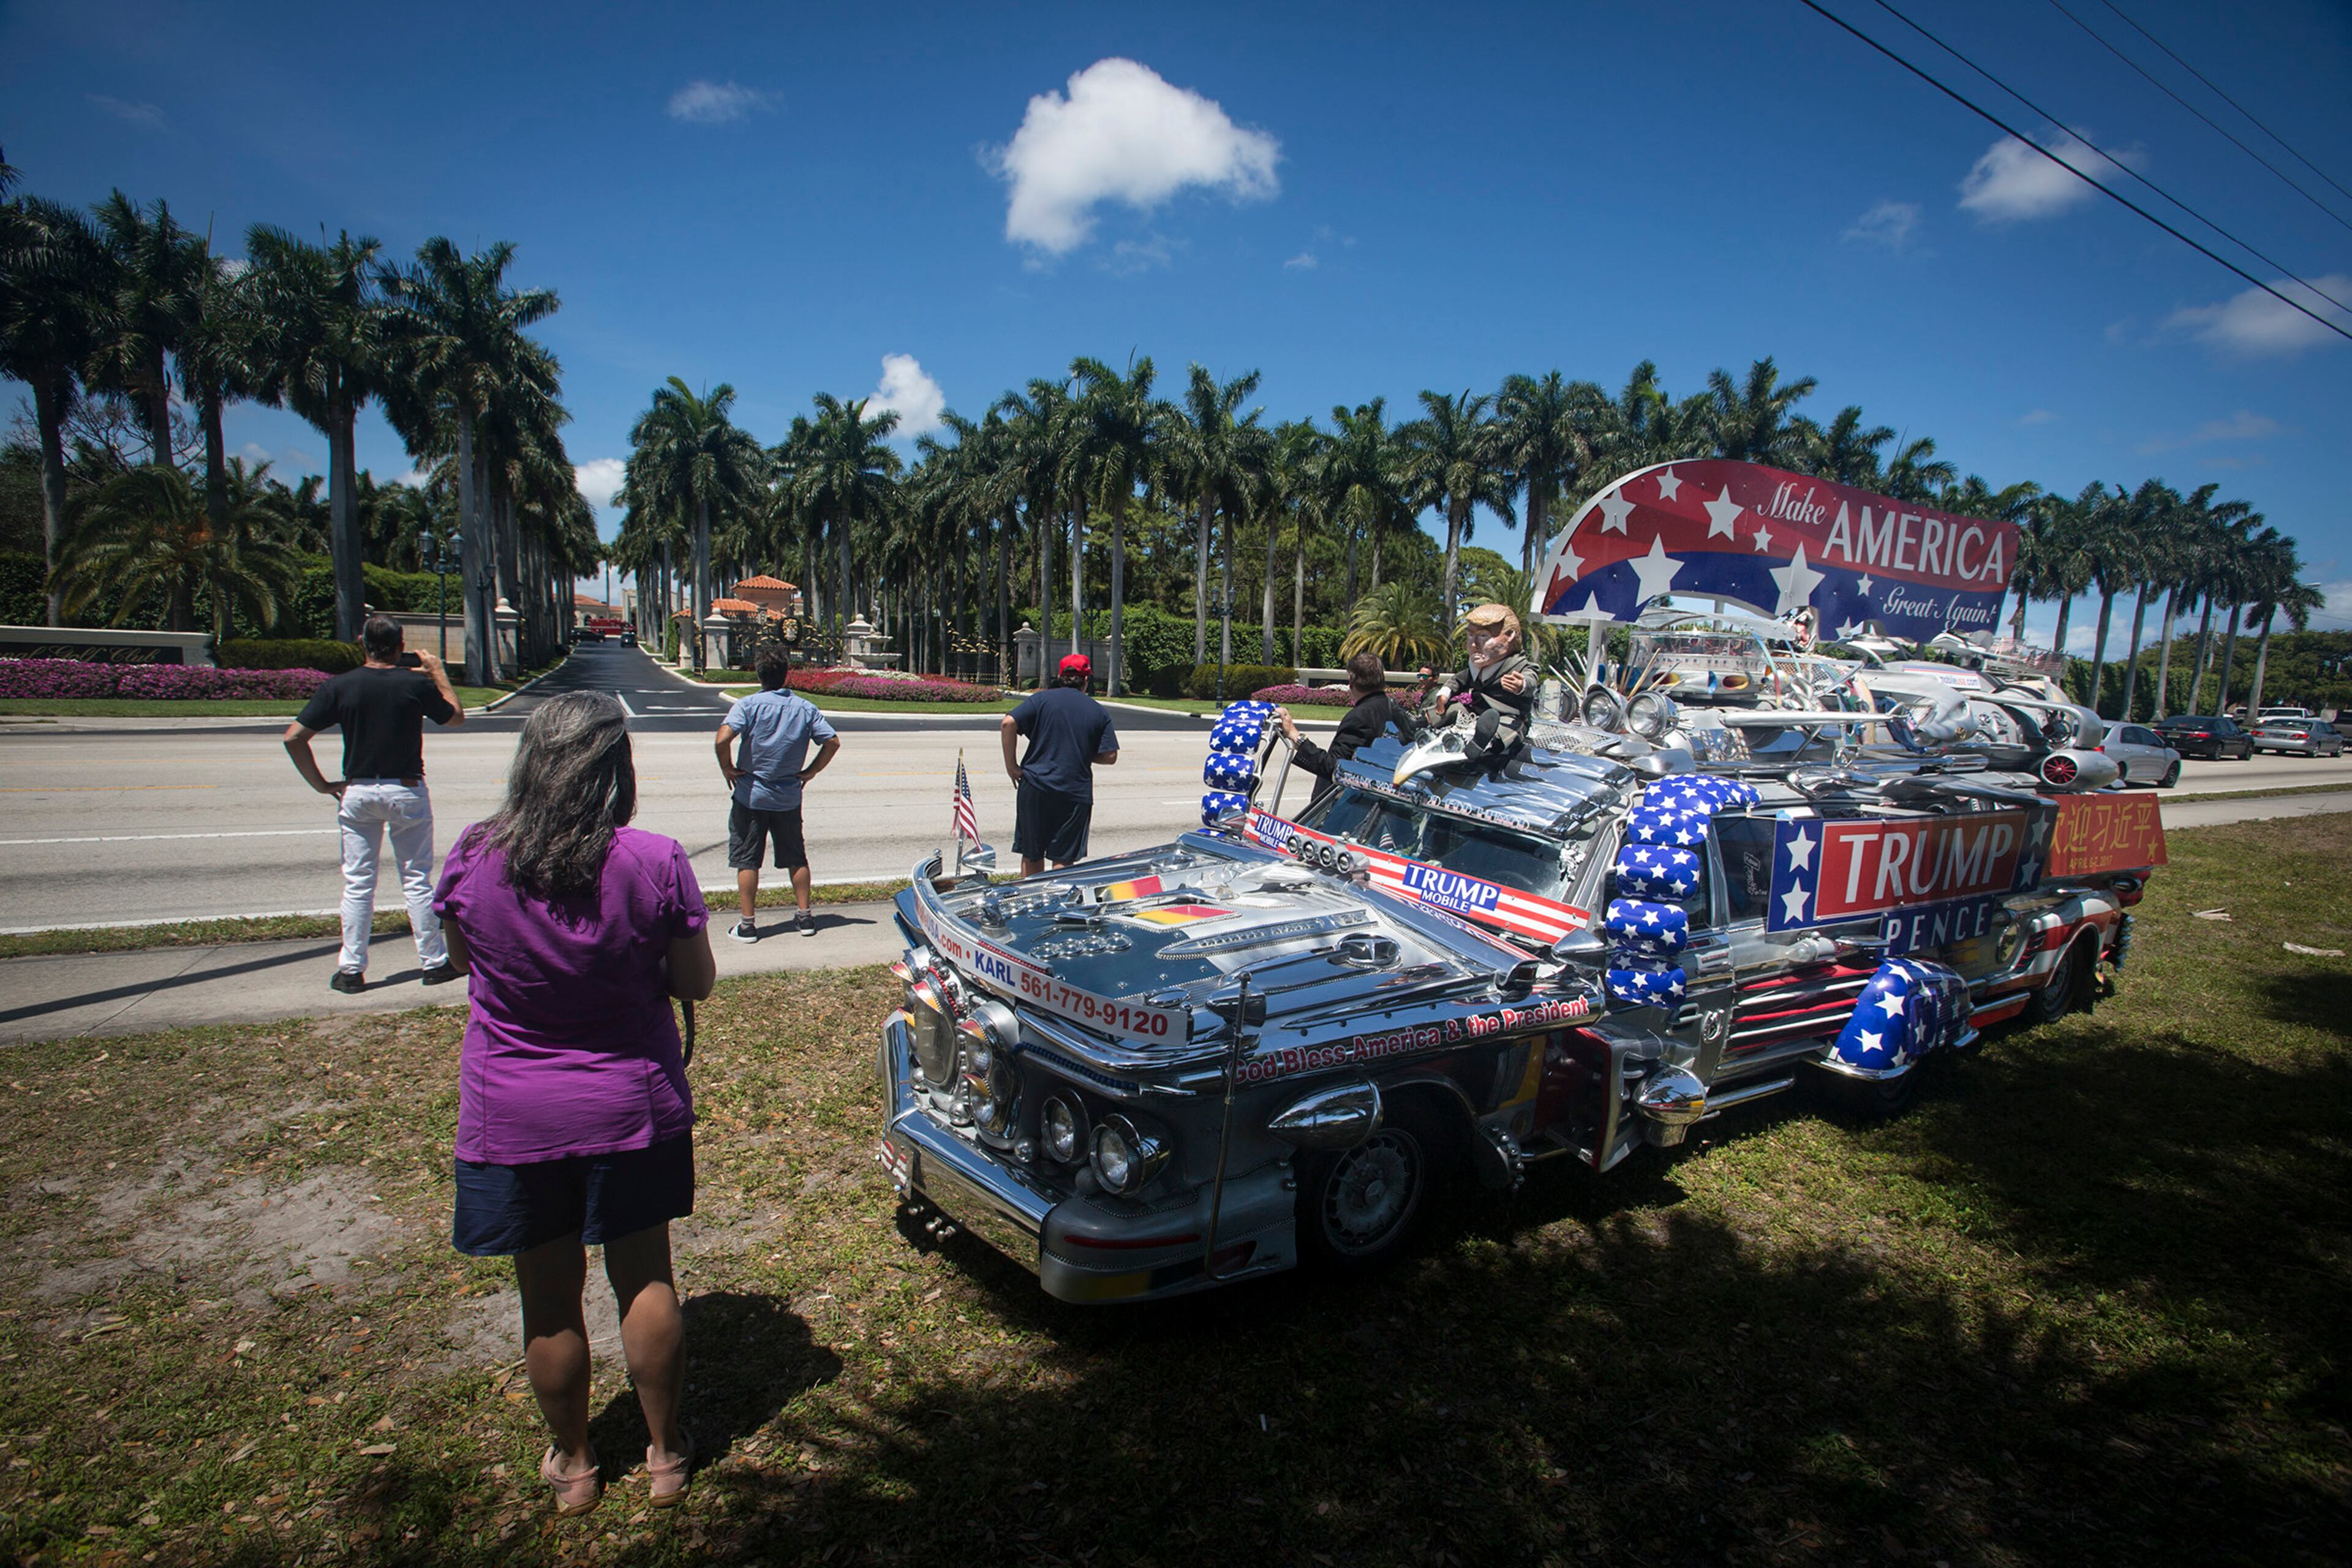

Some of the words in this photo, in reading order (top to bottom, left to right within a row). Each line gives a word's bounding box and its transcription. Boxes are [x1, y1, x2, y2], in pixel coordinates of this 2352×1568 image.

[1757, 481, 1827, 525] Make
[1821, 500, 2003, 584] AMERICA
[1883, 584, 1936, 619] Great
[1935, 594, 1997, 629] Again!
[49, 645, 107, 662] Golf
[110, 647, 161, 663] Club
[1257, 813, 1294, 842] TRUMP
[1259, 833, 1279, 848] MOBILE
[1839, 824, 2013, 903] TRUMP
[2068, 858, 2087, 869] APRIL
[2100, 855, 2113, 867] 2017
[1409, 864, 1498, 906] TRUMP
[1422, 889, 1470, 912] MOBILE
[1883, 903, 1989, 956] PENCE
[975, 950, 1016, 987] KARL
[1021, 971, 1168, 1036] 561-779-9120
[1228, 1052, 1278, 1084] God
[1281, 1045, 1347, 1074] Bless
[1352, 1027, 1440, 1061] America
[1446, 1019, 1462, 1042] &
[1467, 1014, 1500, 1038] the
[1501, 994, 1589, 1031] President
